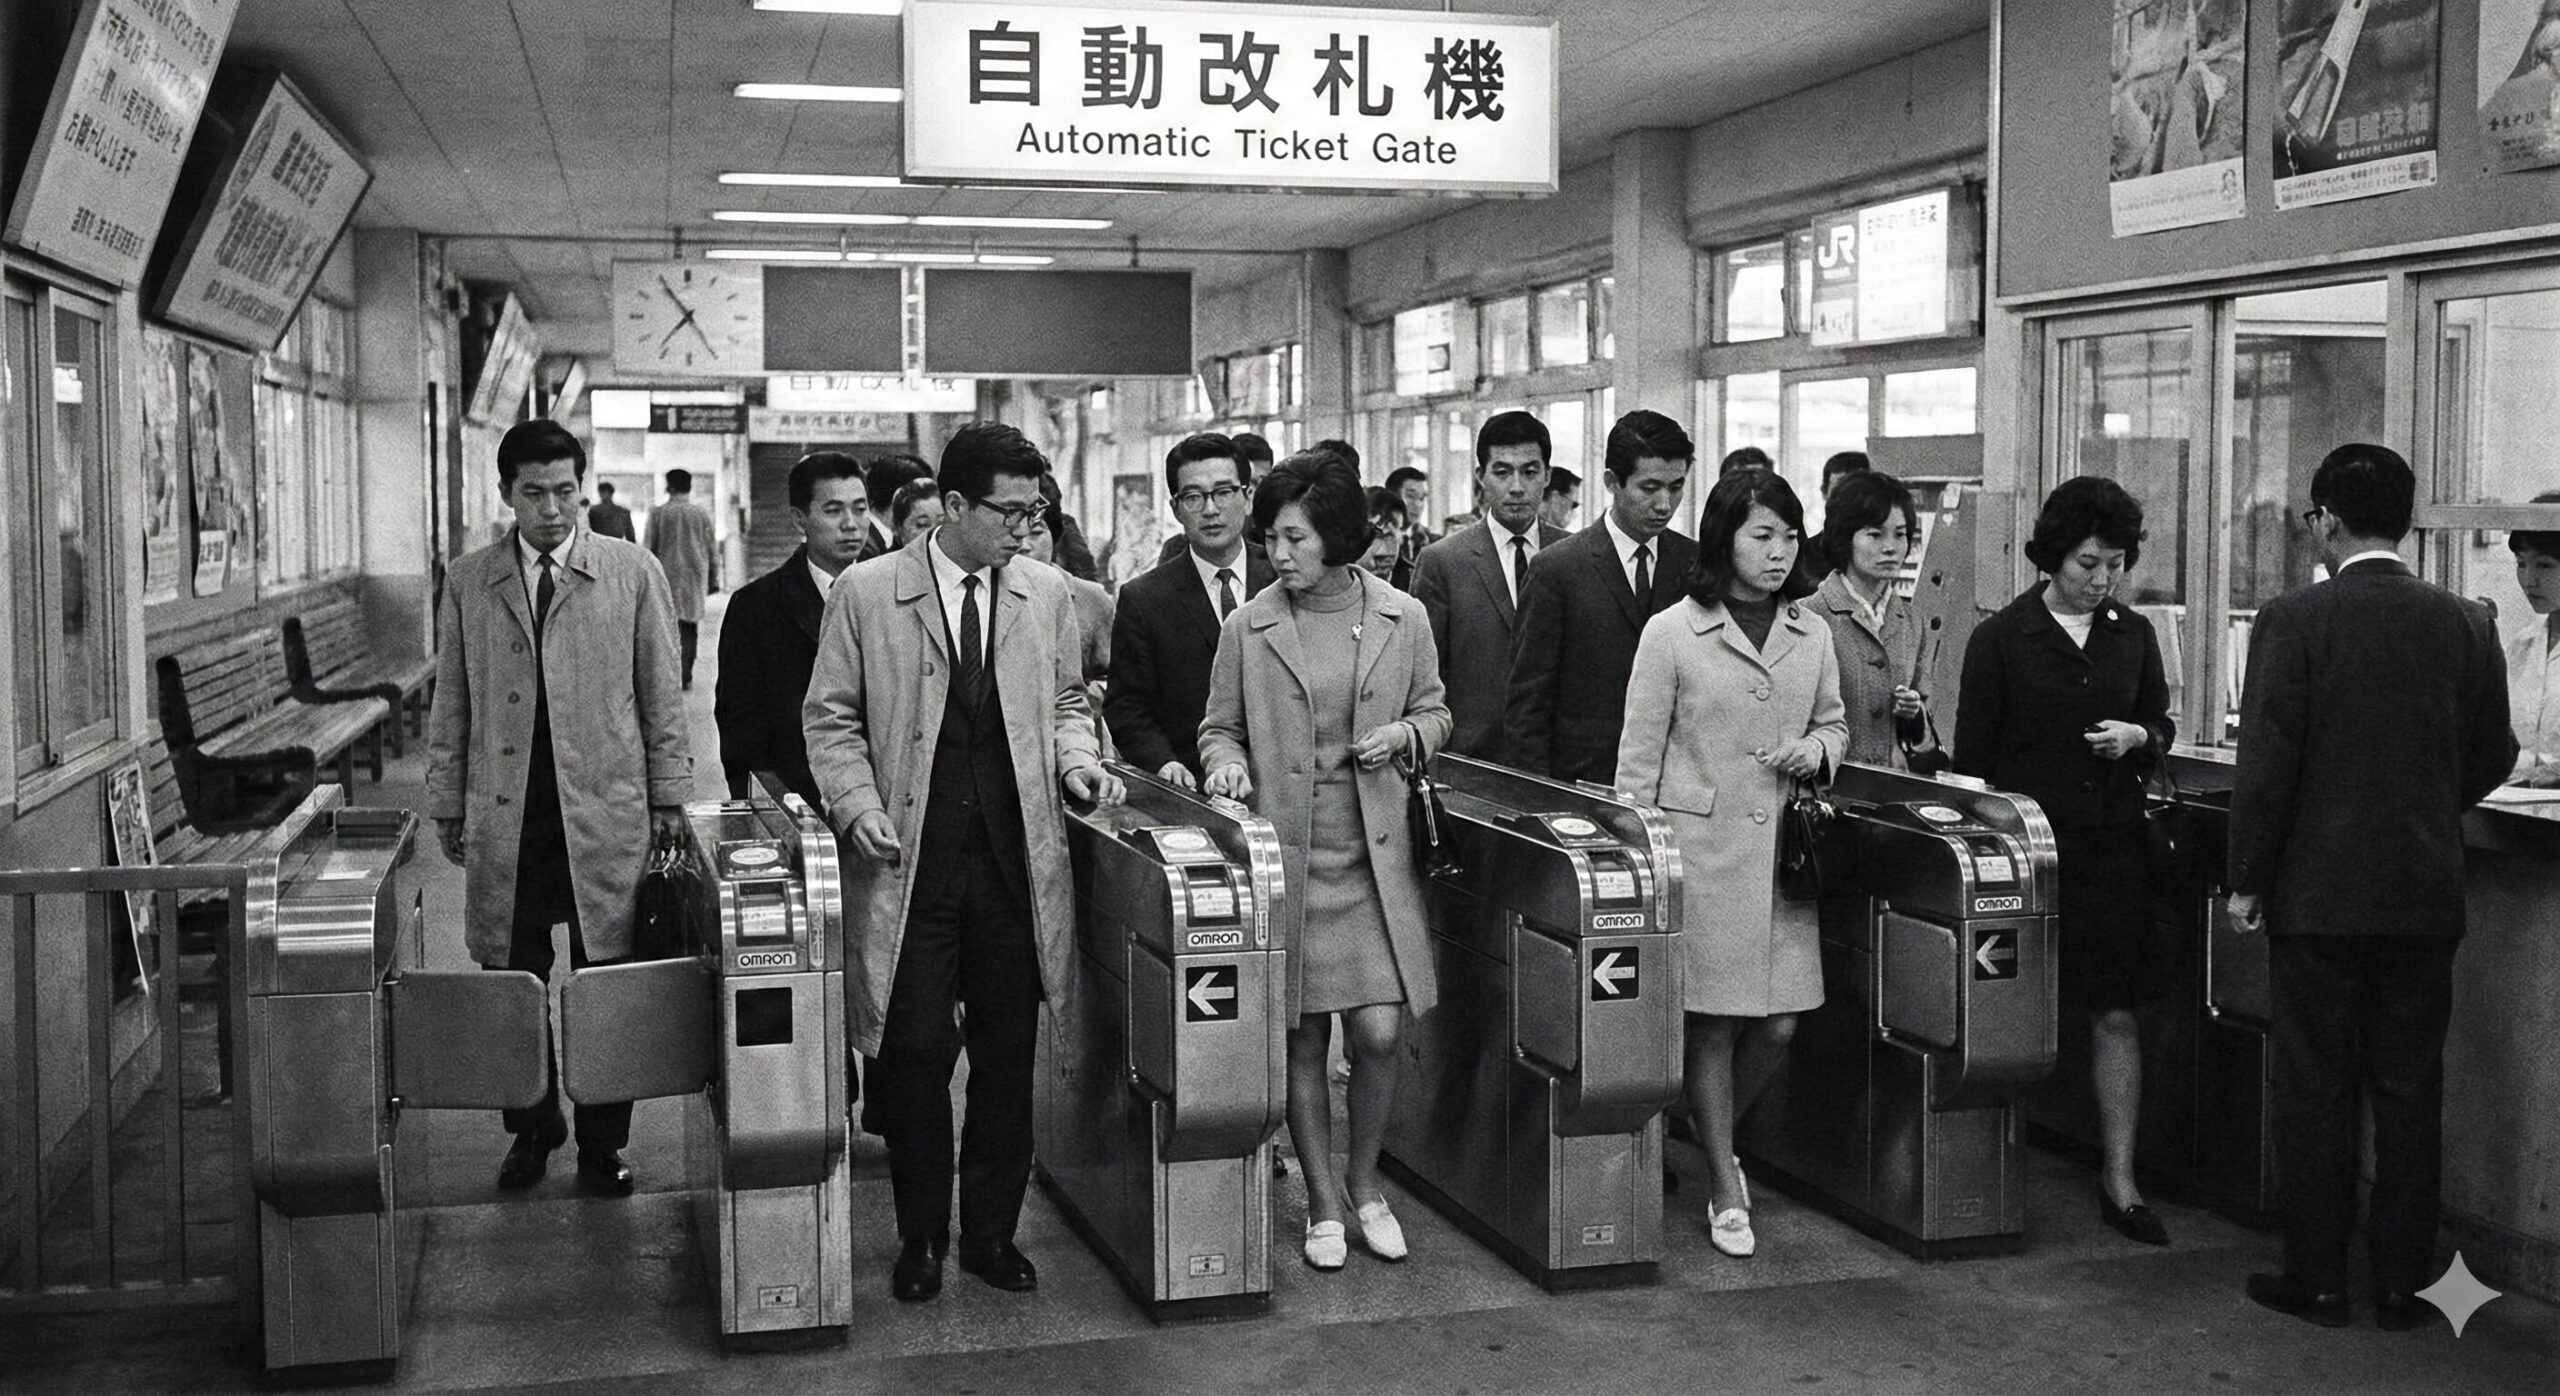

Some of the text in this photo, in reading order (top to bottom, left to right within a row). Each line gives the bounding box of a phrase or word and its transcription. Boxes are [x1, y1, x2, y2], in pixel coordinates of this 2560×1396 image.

[968, 20, 1505, 122] 自動改札機
[1015, 122, 1458, 165] Automatic Ticket Gate
[1818, 224, 1856, 269] JR
[740, 953, 793, 967] OMRON
[1191, 932, 1240, 945] OMRON
